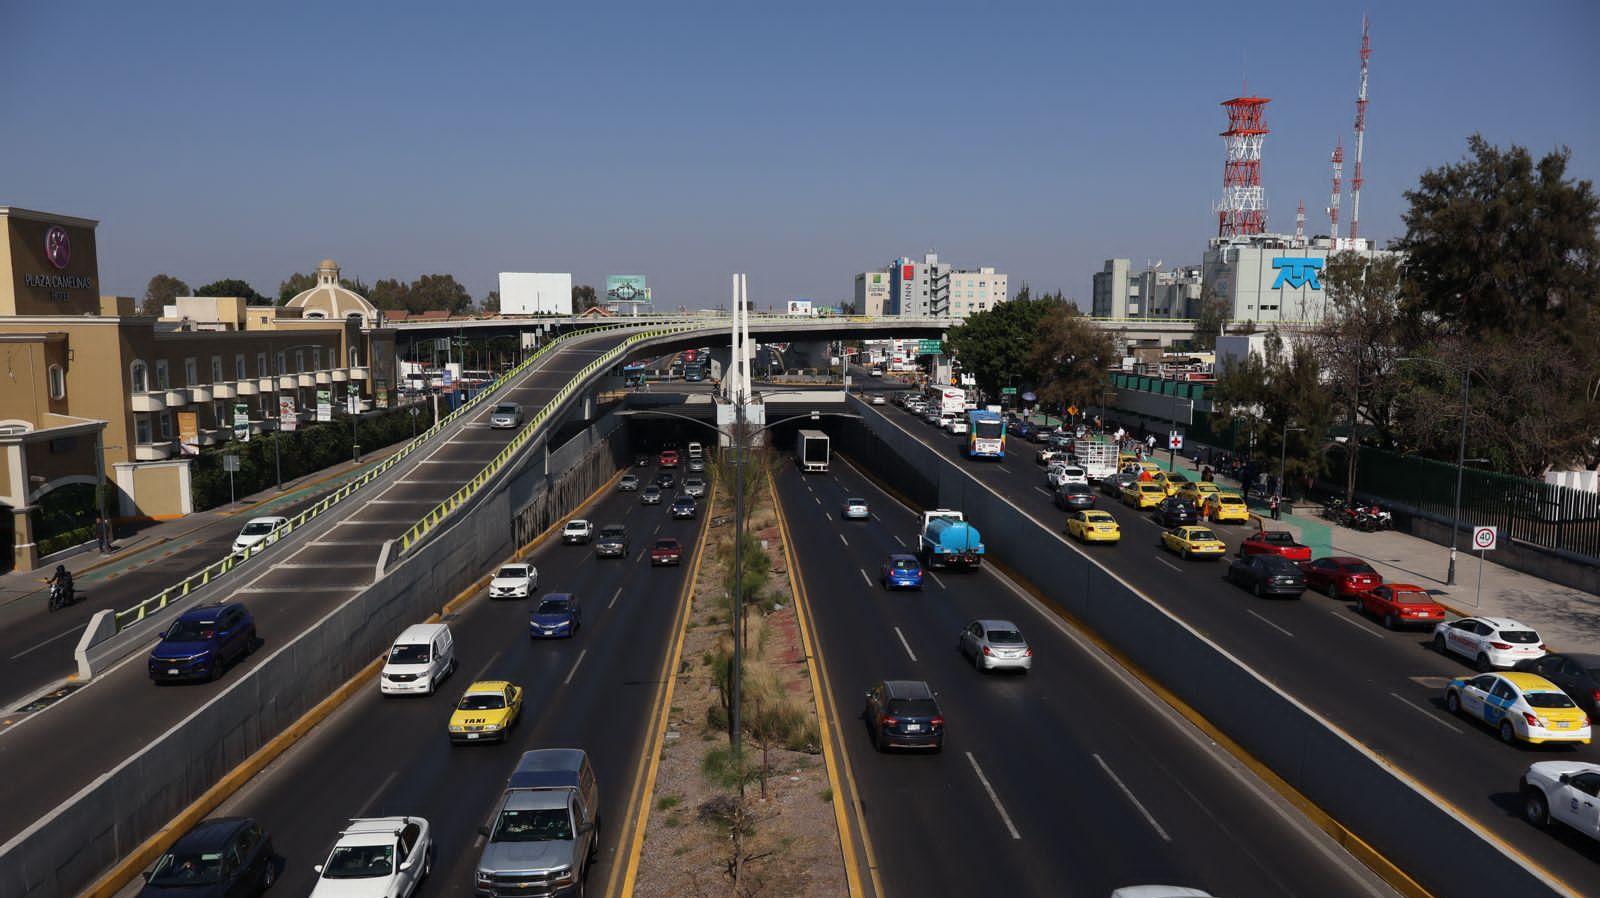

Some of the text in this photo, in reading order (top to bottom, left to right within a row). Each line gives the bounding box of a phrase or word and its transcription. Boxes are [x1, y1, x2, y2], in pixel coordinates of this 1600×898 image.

[25, 273, 90, 288] PLAZA CAMELINAS
[1479, 532, 1491, 542] 40
